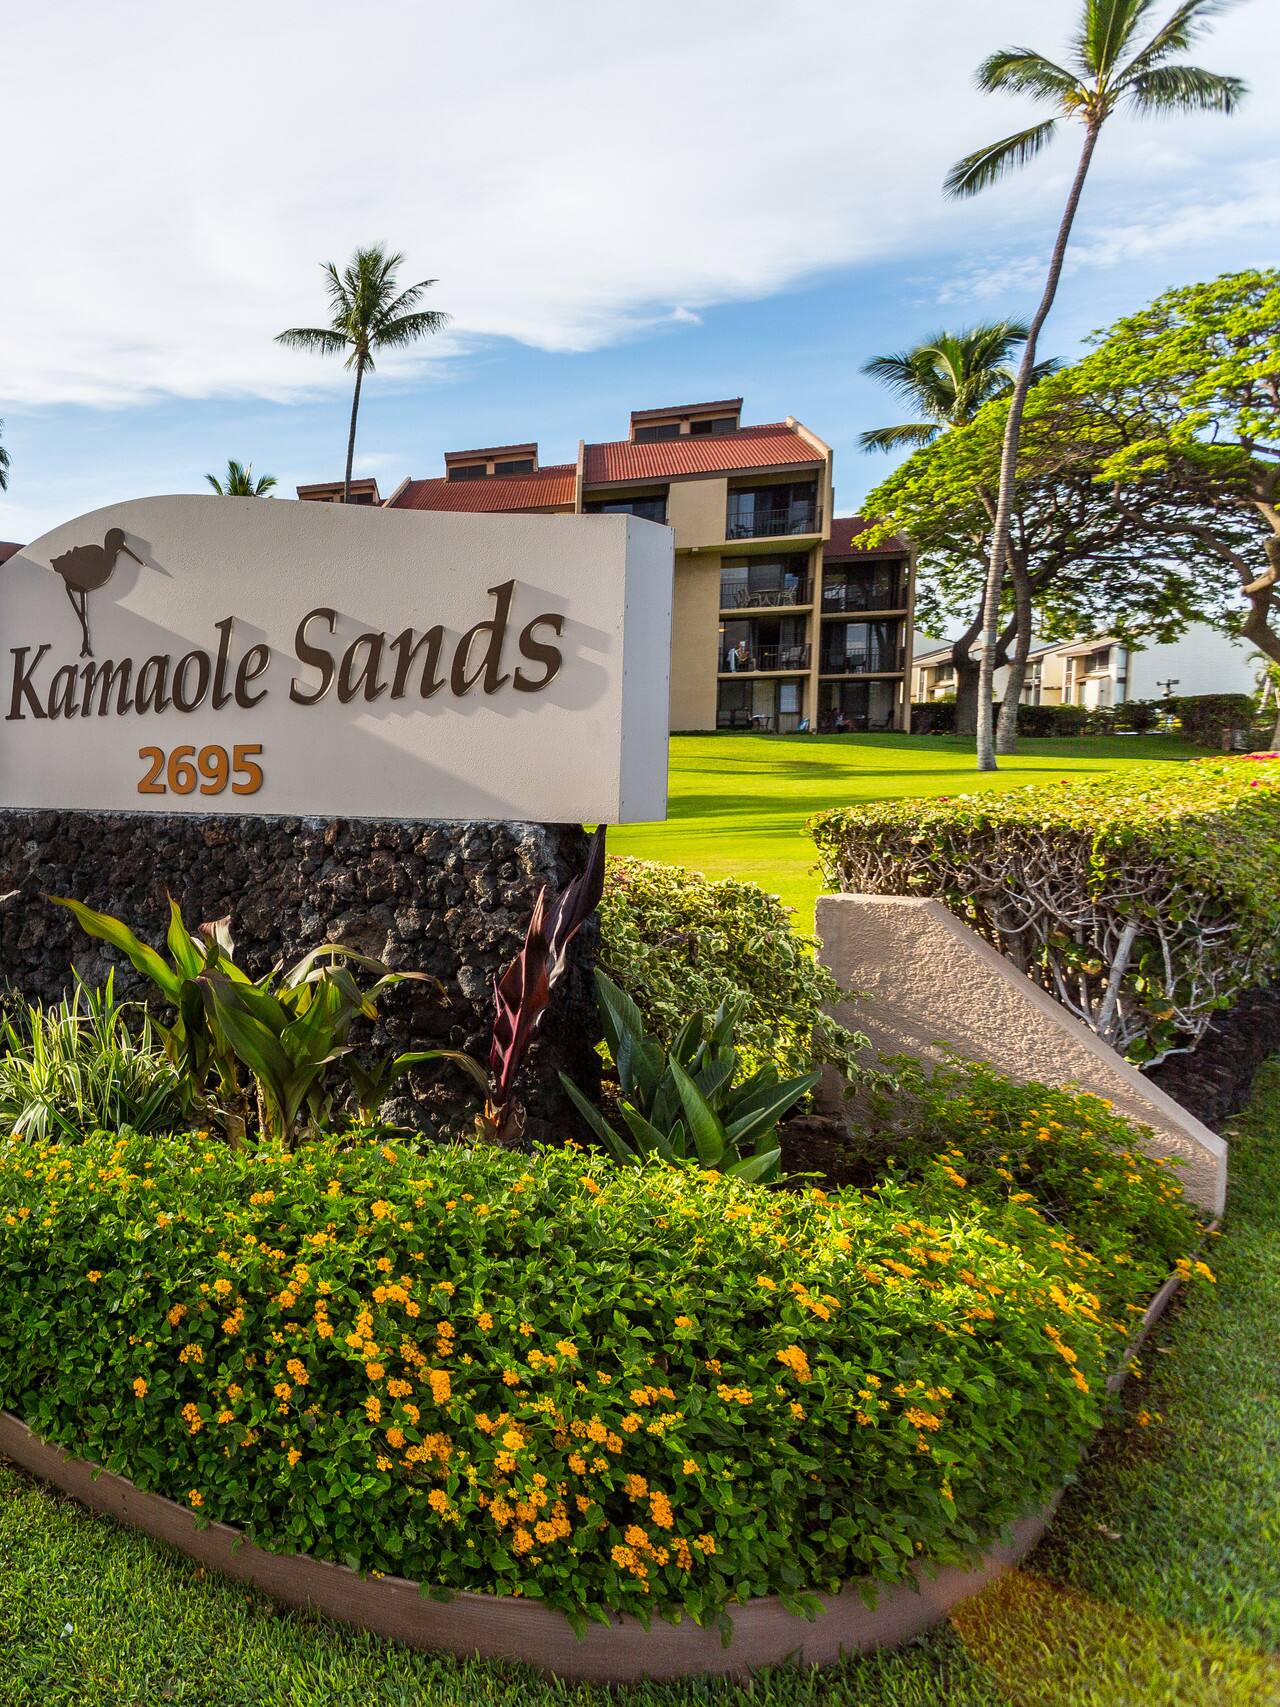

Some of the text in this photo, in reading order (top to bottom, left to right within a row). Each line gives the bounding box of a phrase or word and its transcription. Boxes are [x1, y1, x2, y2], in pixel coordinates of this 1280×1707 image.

[5, 578, 565, 721] Kamaole Sands
[137, 743, 264, 795] 2695
